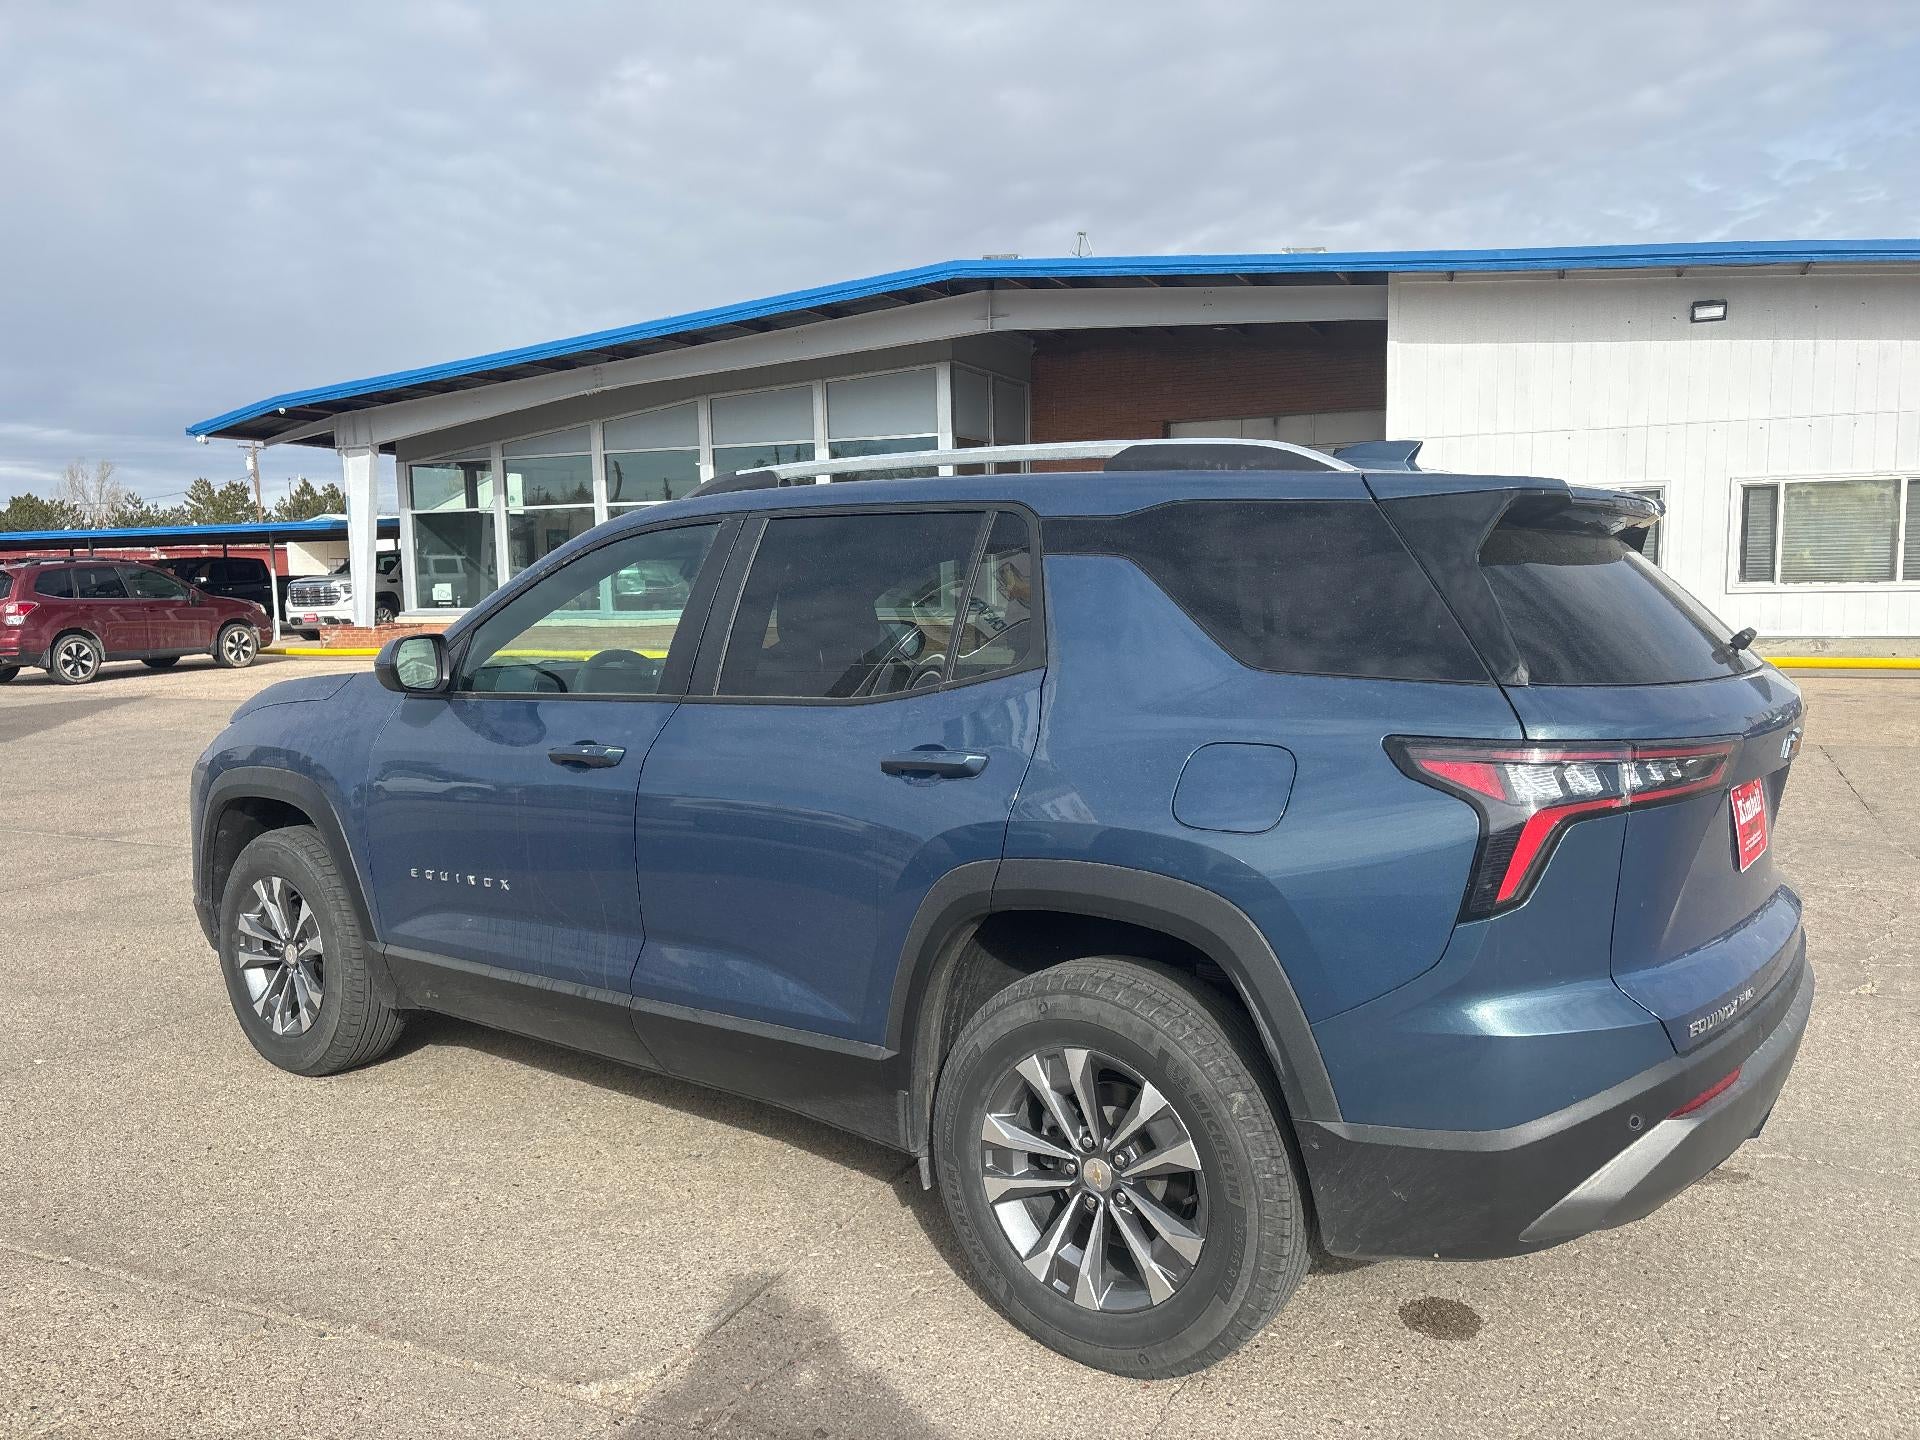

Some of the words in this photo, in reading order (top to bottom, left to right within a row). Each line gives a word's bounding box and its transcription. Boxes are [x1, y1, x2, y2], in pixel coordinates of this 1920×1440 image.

[410, 868, 510, 891] EQUINOX
[1689, 998, 1738, 1038] EQUINOX
[1188, 1093, 1241, 1200] MICHELIN
